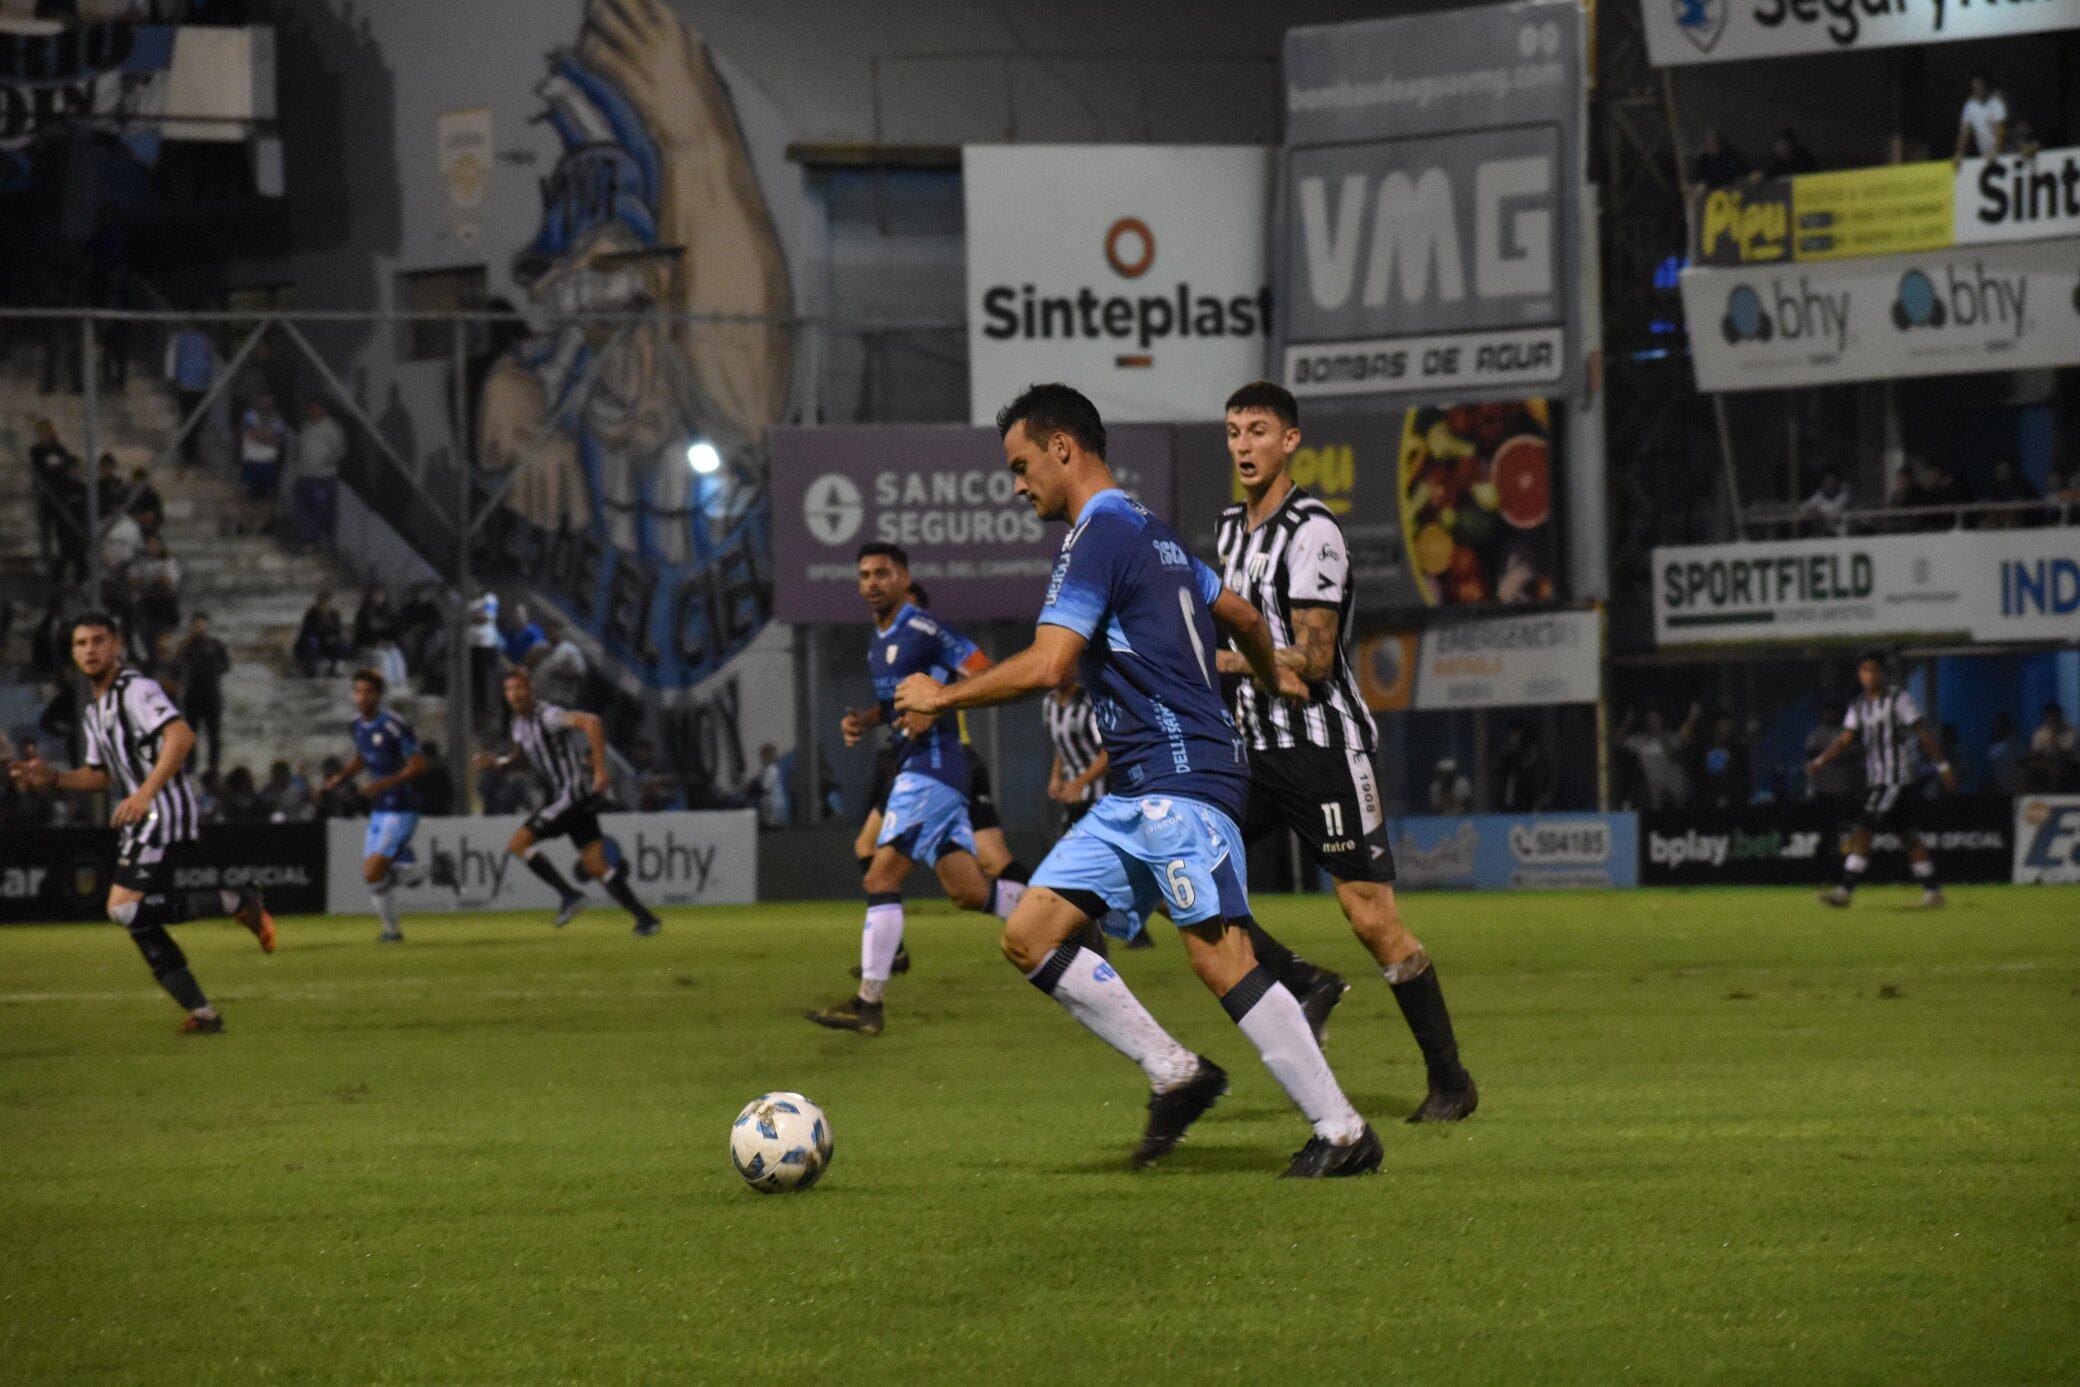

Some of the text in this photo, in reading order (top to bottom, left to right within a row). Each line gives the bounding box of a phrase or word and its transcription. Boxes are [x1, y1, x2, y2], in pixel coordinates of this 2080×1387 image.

[1978, 146, 2080, 225] Sint
[1301, 155, 1553, 311] VMG
[982, 281, 1273, 350] Sinteplast
[1774, 276, 1850, 353] bhy
[1948, 260, 2027, 338] bhy
[1294, 340, 1553, 384] BOMBAS DE AGUA
[875, 469, 1033, 505] SANCO
[875, 511, 1045, 545] SEGUROS
[1664, 552, 1874, 608] SPORTFIELD
[2001, 559, 2080, 617] IND
[1320, 801, 1344, 837] 11
[1358, 773, 1377, 814] 1908
[636, 832, 715, 893] bhy
[1322, 839, 1356, 854] mitre
[1166, 859, 1196, 910] 6
